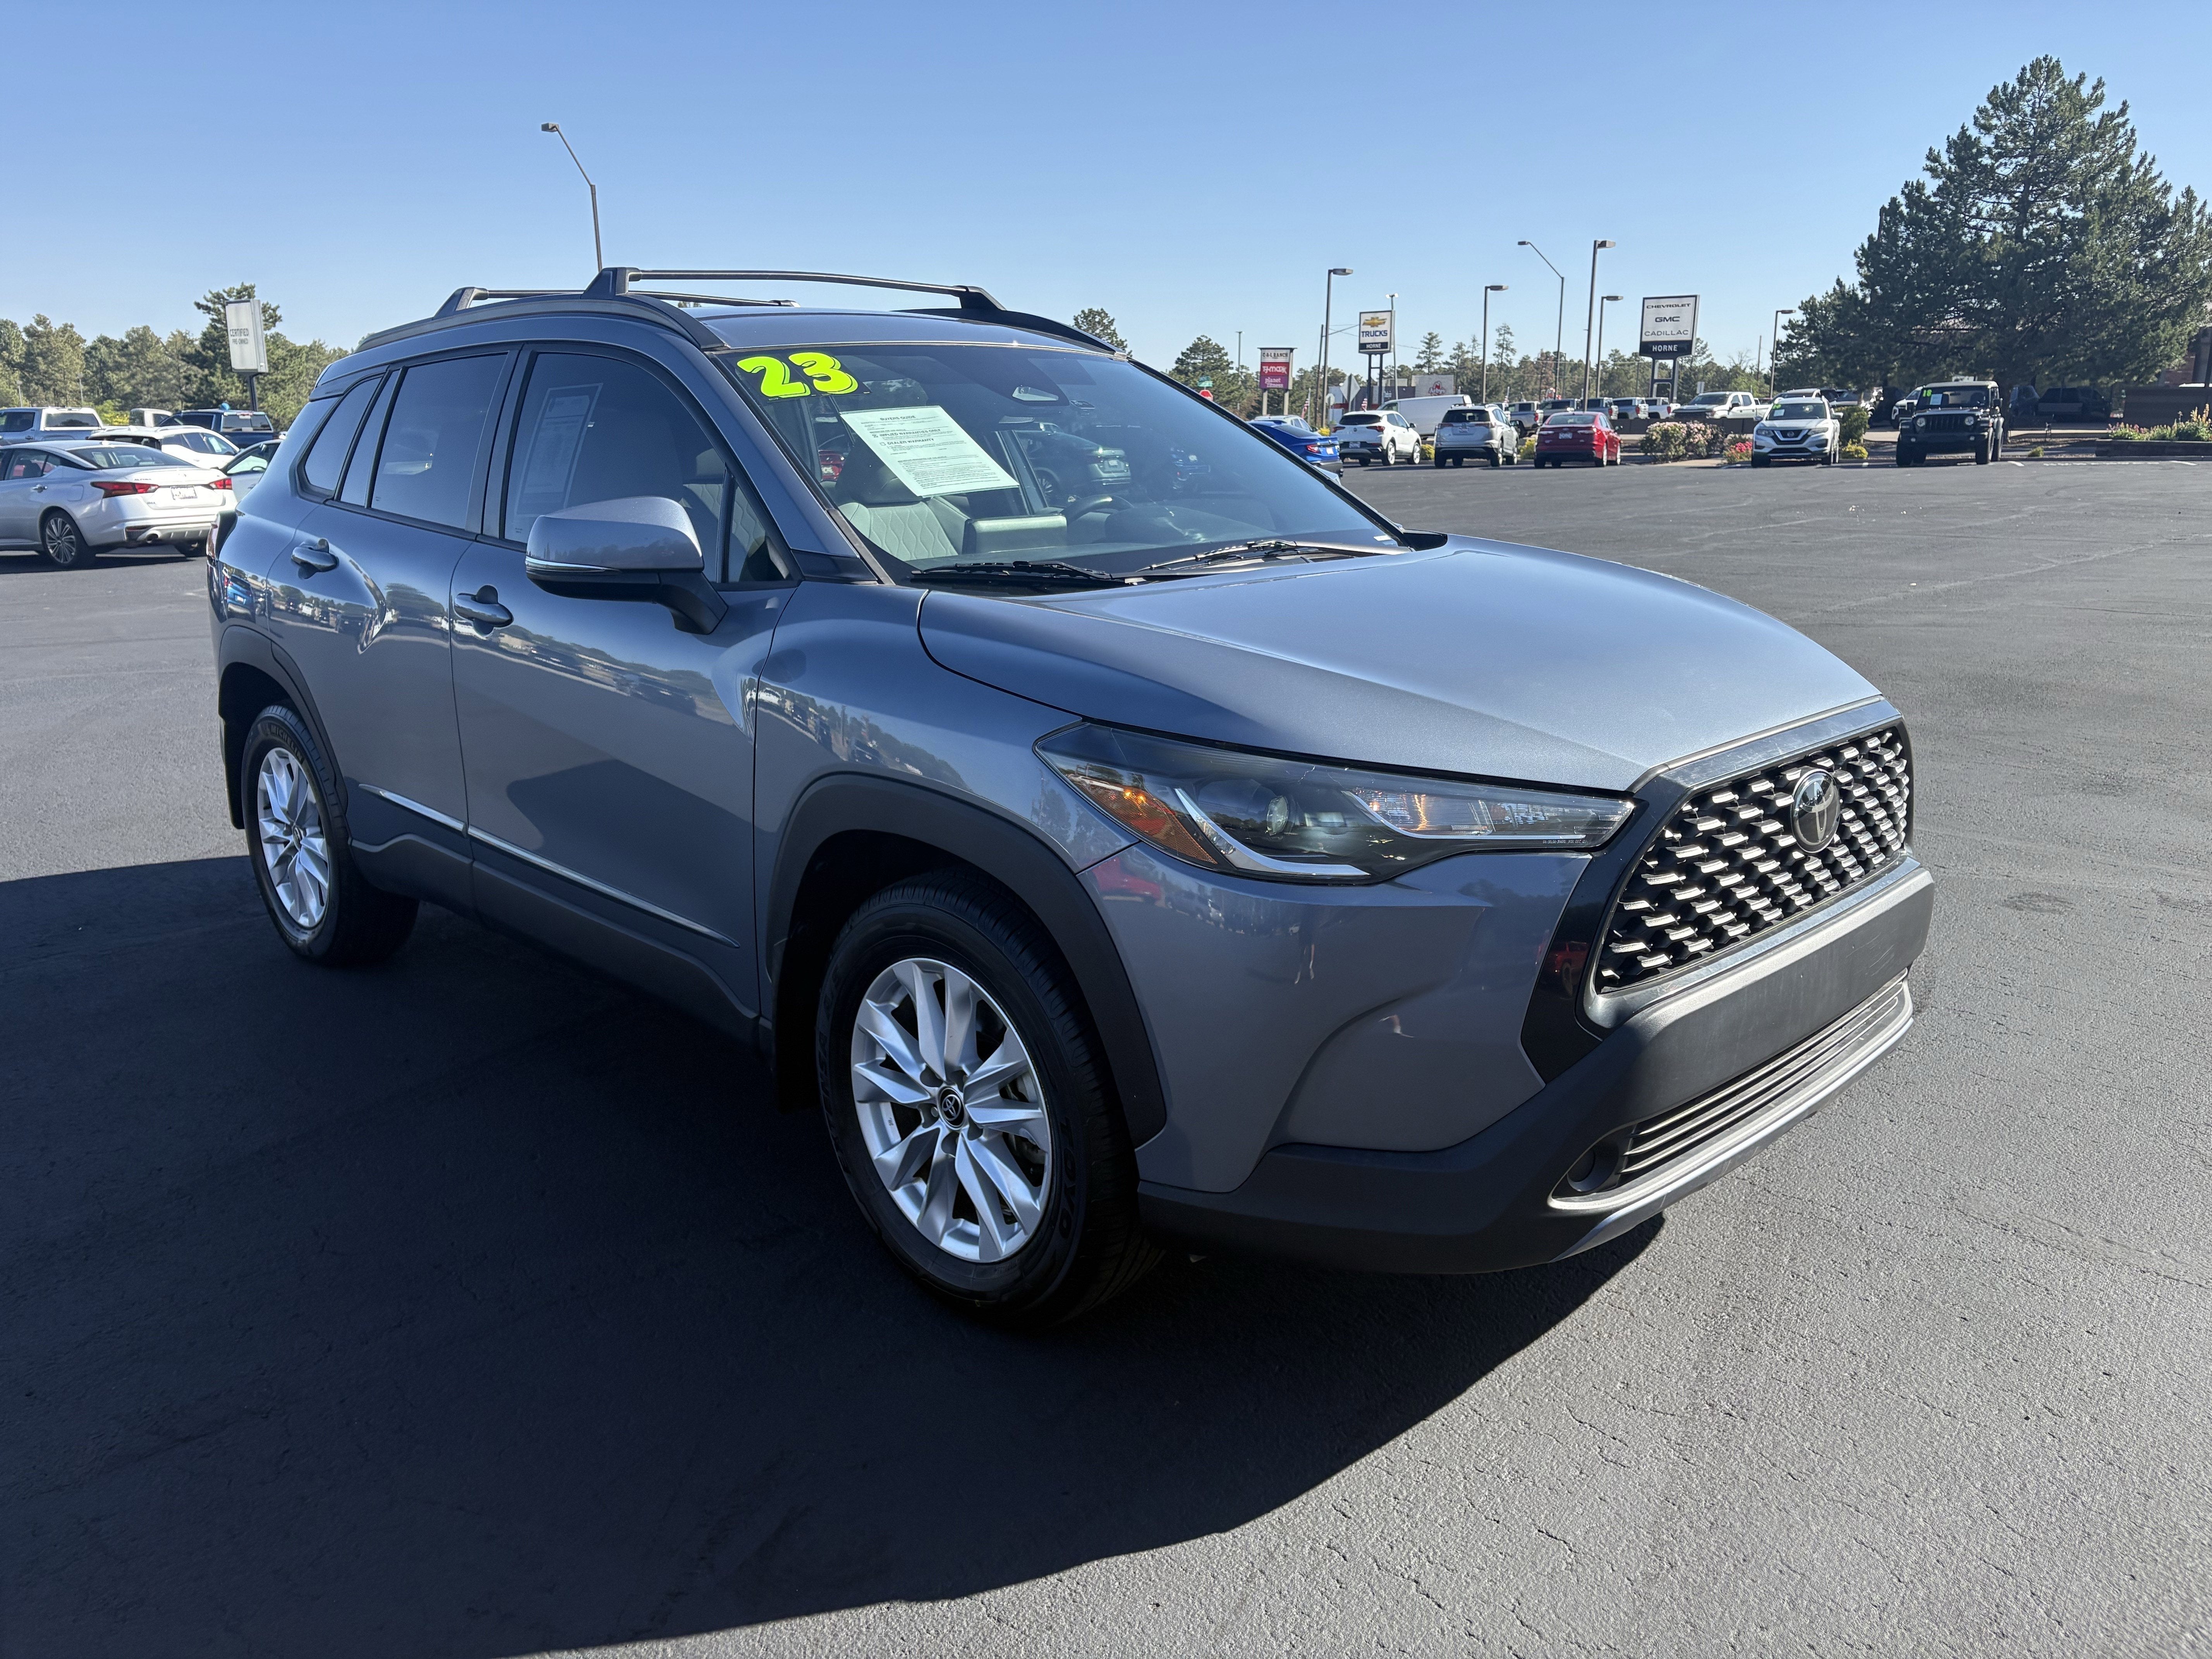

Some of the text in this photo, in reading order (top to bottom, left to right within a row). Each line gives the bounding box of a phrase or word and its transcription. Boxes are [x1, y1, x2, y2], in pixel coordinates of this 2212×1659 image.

[230, 328, 249, 337] CERTIFIED
[737, 352, 858, 398] 23
[270, 722, 305, 764] MICHELIN
[1060, 1116, 1076, 1239] TOYO
